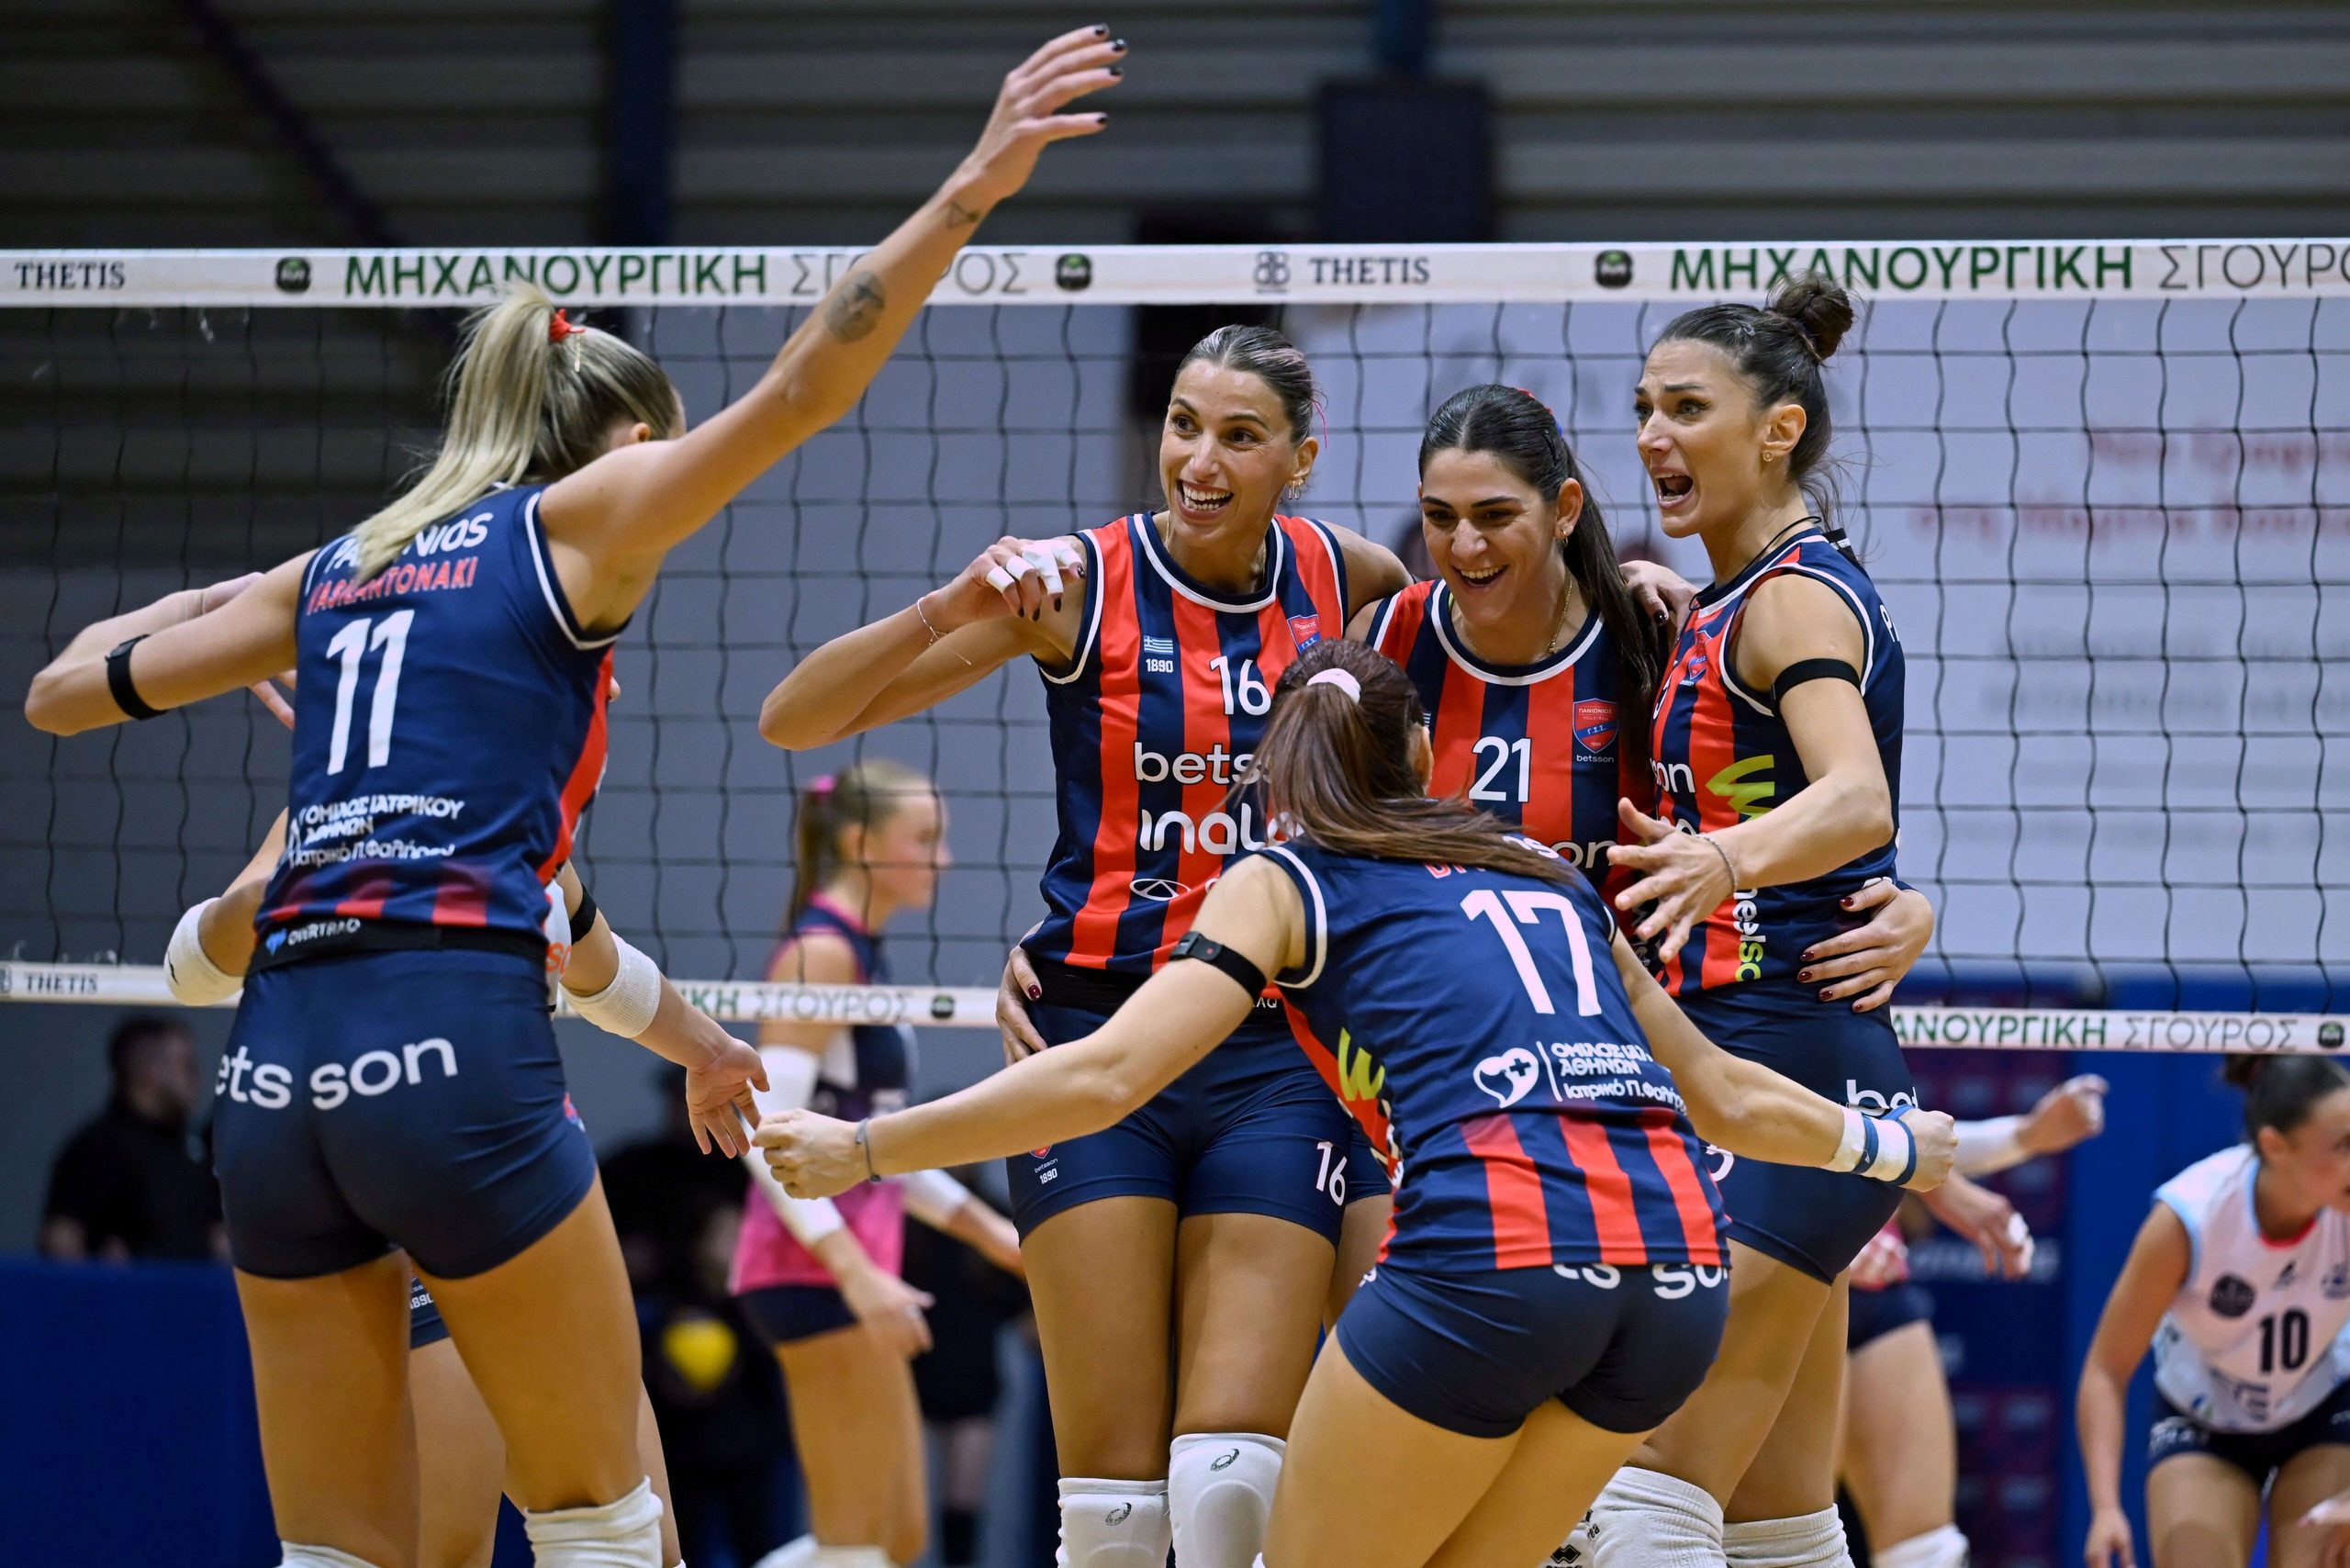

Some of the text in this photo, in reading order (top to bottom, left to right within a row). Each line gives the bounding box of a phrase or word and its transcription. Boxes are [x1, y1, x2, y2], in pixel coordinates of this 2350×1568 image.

[14, 262, 126, 291] THETIS
[1308, 257, 1431, 286] THETIS
[2158, 243, 2350, 289] ΣΓΟΥΡ
[1146, 658, 1174, 673] 1890
[1210, 655, 1272, 716] 16
[326, 609, 415, 776] 11
[1469, 736, 1532, 803] 21
[1576, 755, 1615, 763] betsson
[1460, 890, 1602, 1016] 17
[2124, 1017, 2300, 1053] ΣΓΟΥΡΟΣ
[1559, 1058, 1641, 1077] ΑΘΗΝΩΝ
[1039, 1168, 1058, 1184] 1890
[1316, 1142, 1348, 1206] 16
[2259, 1309, 2310, 1373] 10
